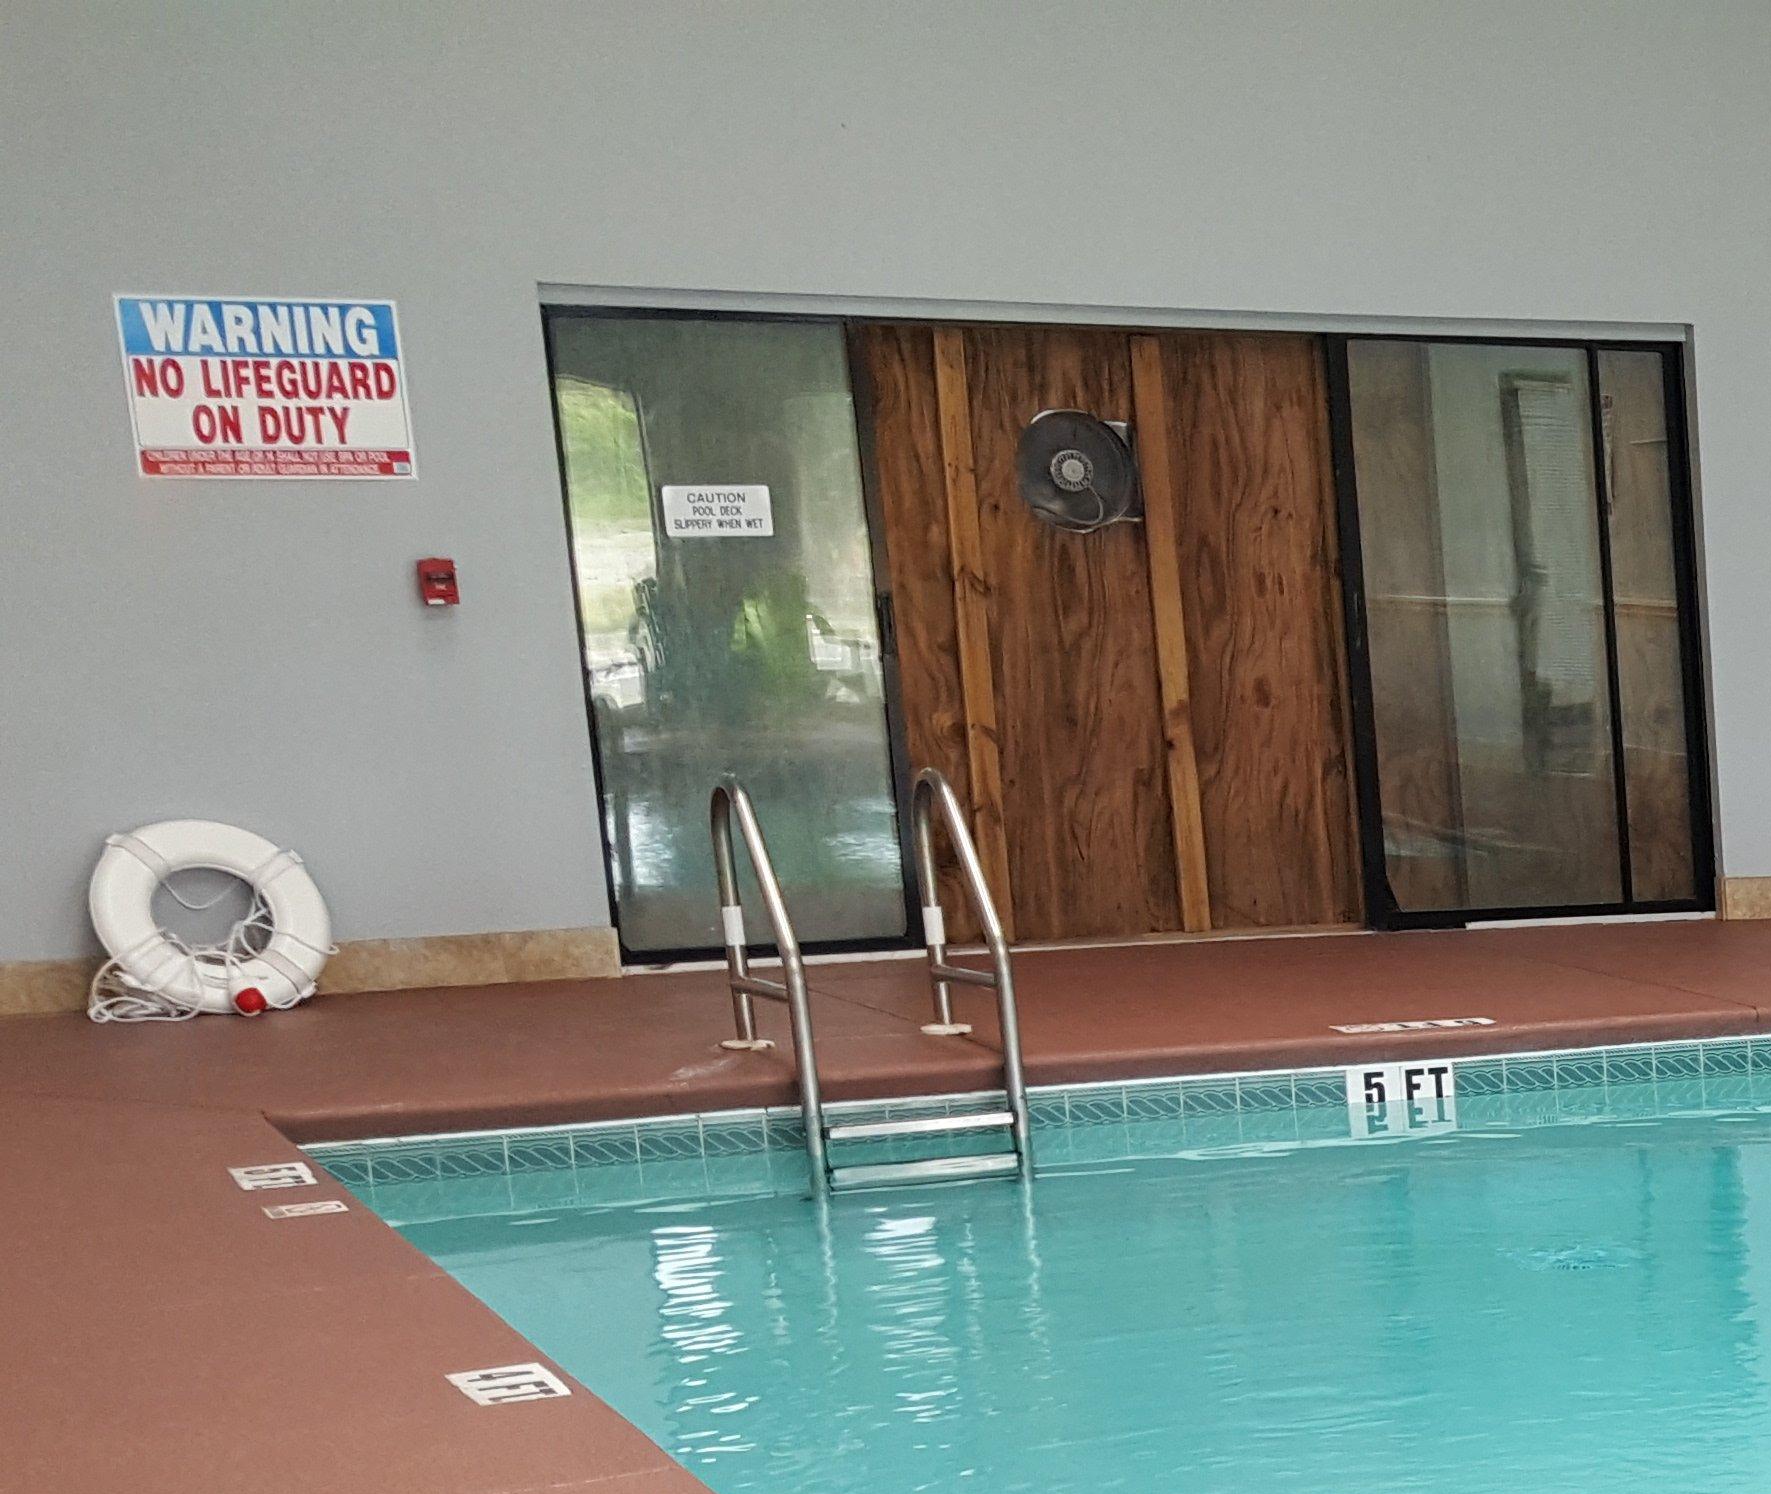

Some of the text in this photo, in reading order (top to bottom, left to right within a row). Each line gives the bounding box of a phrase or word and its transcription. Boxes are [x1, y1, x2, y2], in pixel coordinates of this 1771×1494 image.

[138, 301, 380, 356] WARNING
[132, 357, 396, 400] NO LIFEGUARD
[192, 404, 350, 446] ON DUTY
[687, 492, 746, 503] CAUTION
[692, 506, 742, 516] POOL DECK
[674, 518, 764, 530] SLIPPERY WHEN WET
[1364, 1071, 1386, 1103] 5
